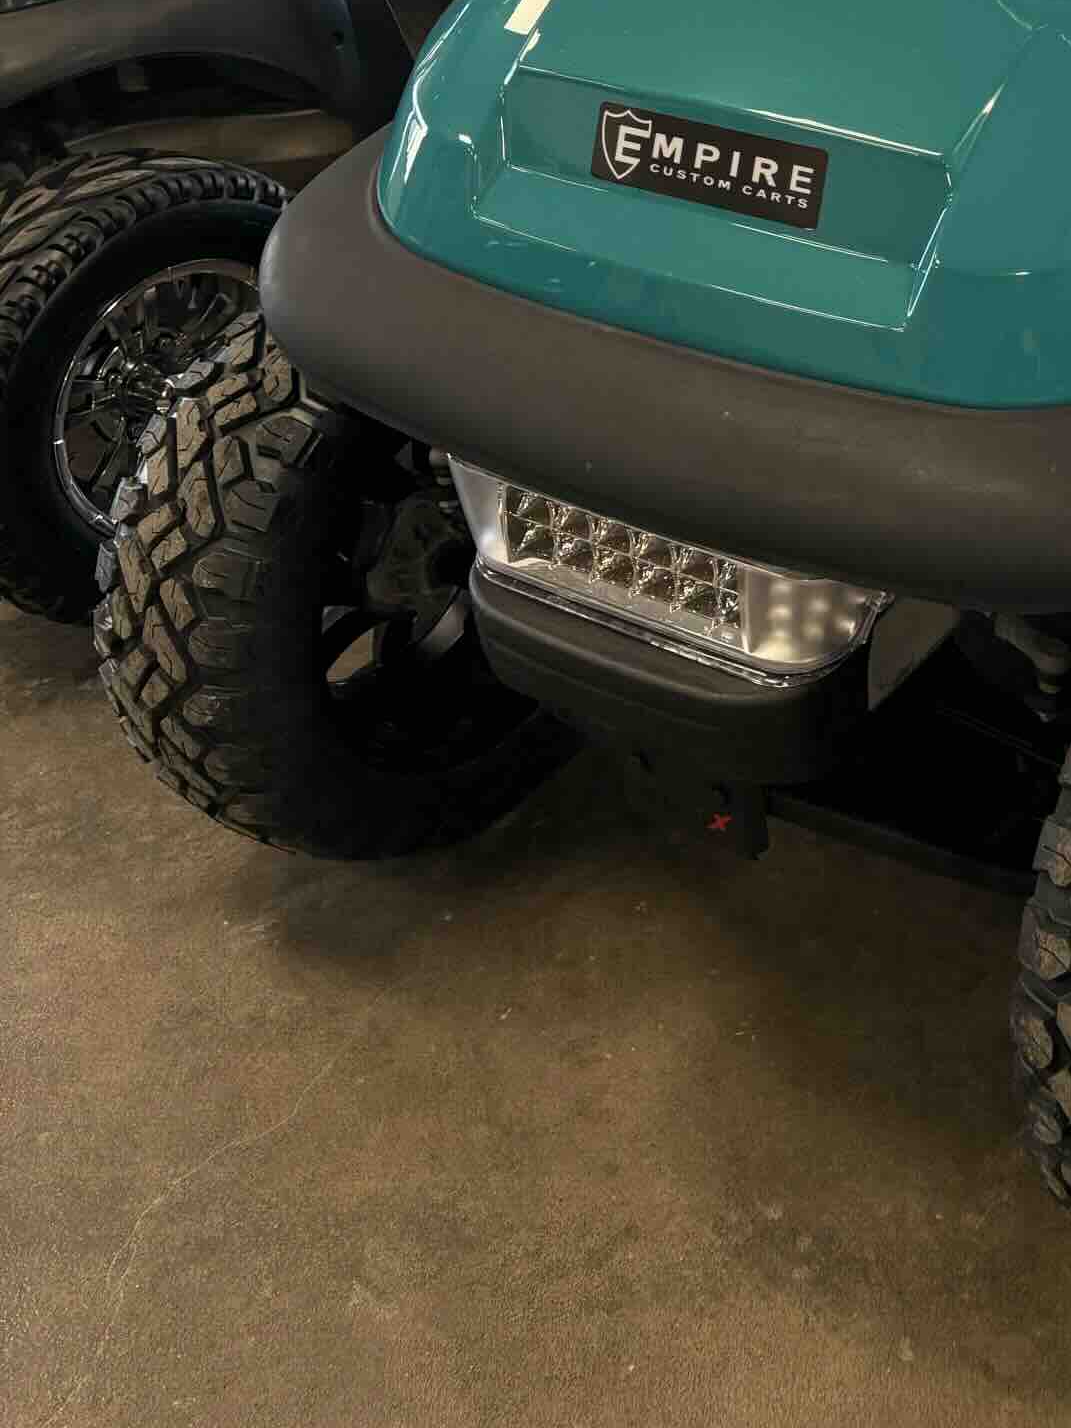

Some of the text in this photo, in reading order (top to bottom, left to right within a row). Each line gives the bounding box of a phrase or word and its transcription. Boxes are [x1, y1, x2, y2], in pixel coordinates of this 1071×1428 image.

[614, 124, 815, 195] EMPIRE
[650, 163, 809, 209] CUSTOM CARTS
